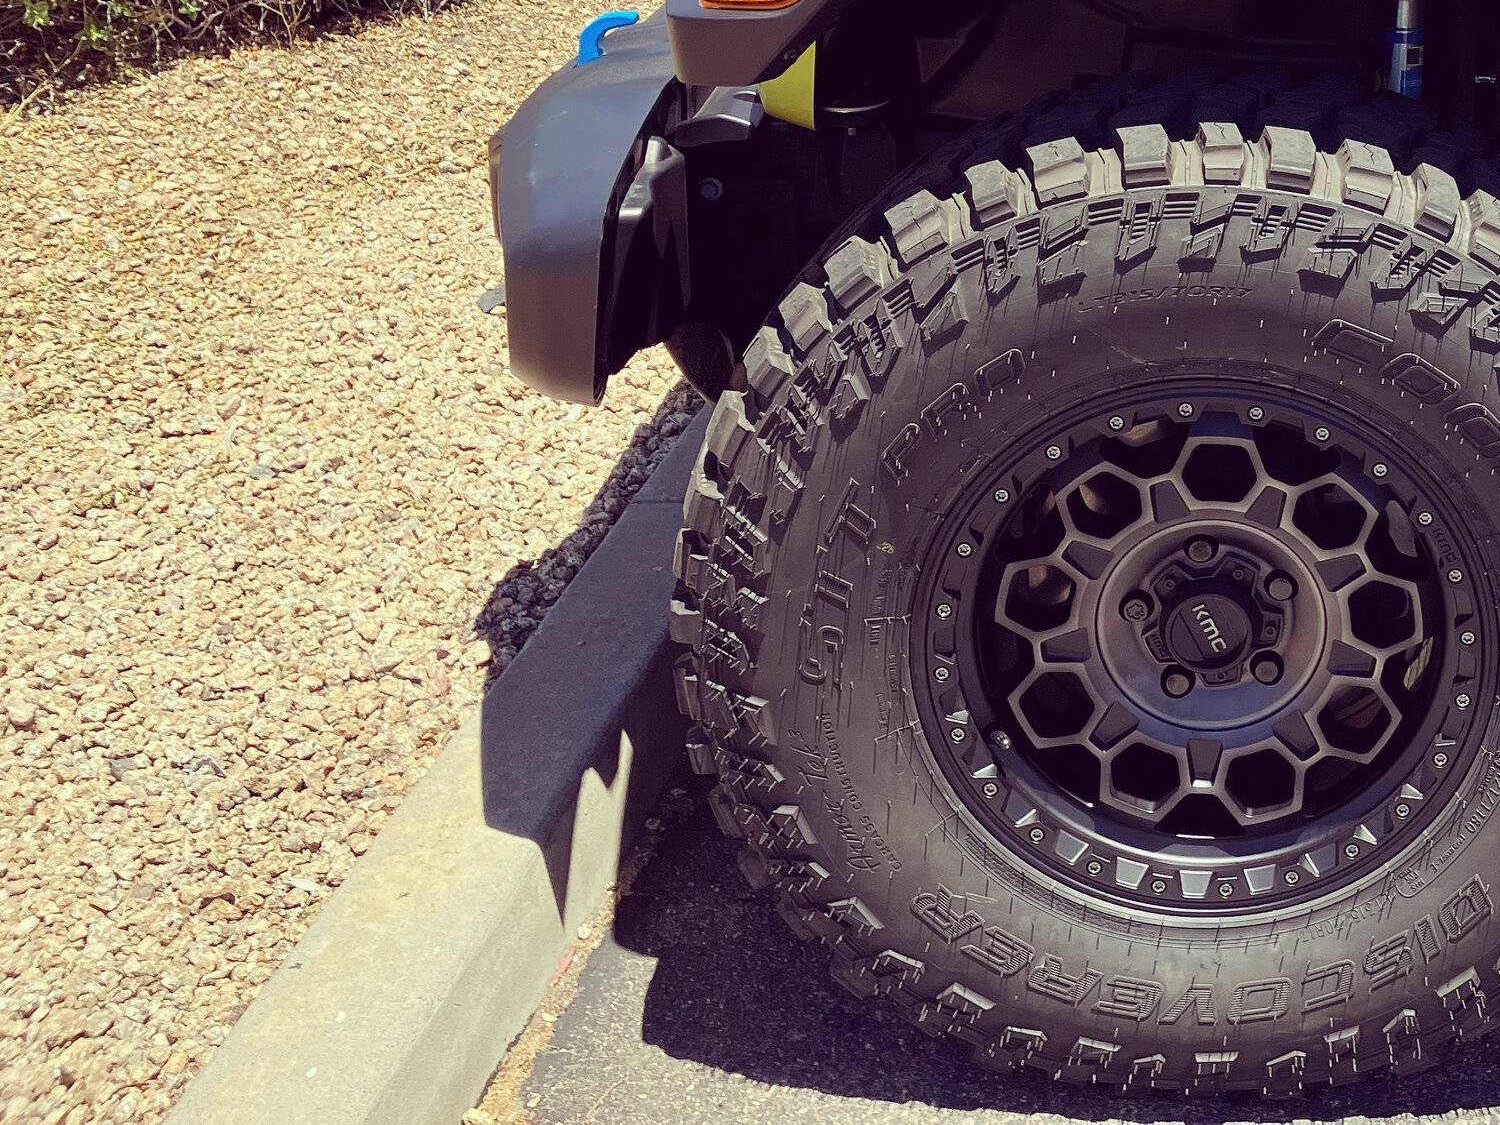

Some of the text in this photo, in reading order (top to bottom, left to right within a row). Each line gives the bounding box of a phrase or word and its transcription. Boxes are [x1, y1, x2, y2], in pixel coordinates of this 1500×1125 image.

[880, 347, 1028, 487] PRO
[1192, 603, 1228, 653] KMC
[821, 712, 902, 871] CARCASS CONSTRUCTION
[910, 873, 1494, 1026] DISCOVERER
